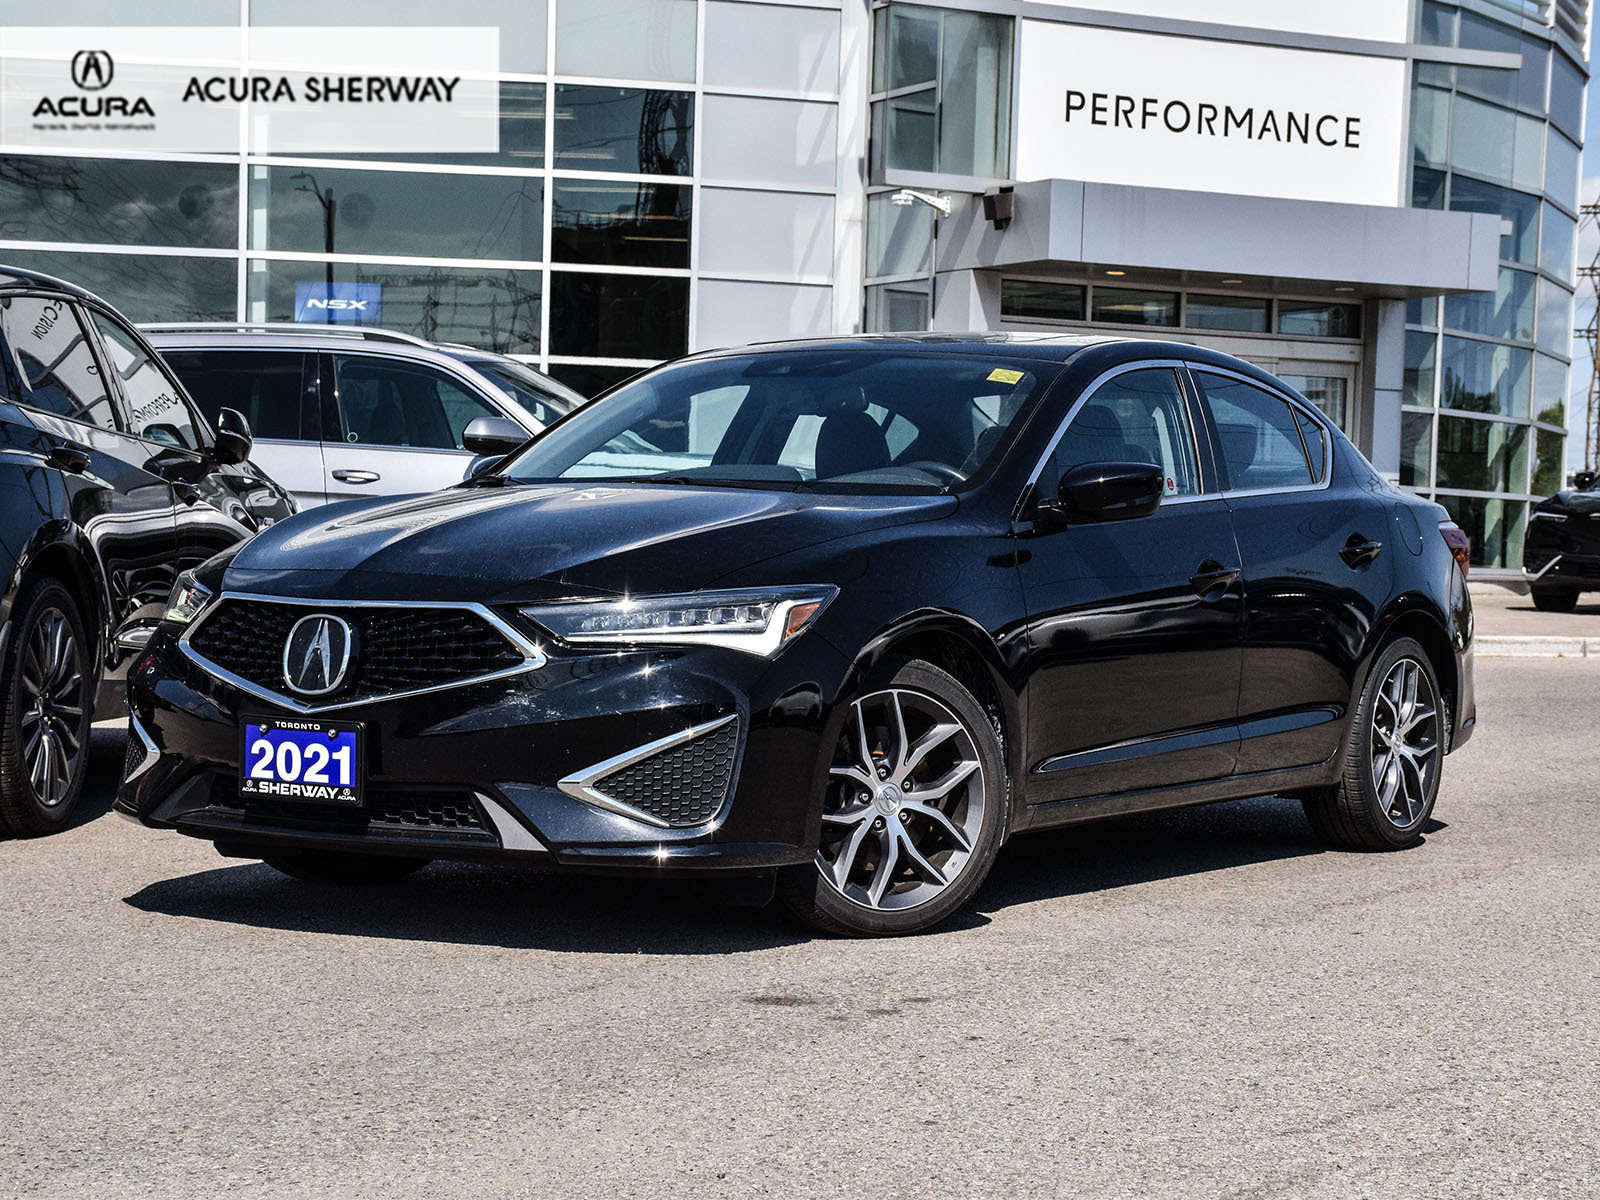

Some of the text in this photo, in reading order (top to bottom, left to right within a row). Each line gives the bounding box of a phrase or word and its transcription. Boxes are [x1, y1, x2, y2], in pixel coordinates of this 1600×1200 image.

[1065, 89, 1361, 148] PERFORMANCE
[306, 298, 368, 311] NSX
[275, 721, 321, 731] TORONTO
[250, 739, 350, 785] 2021
[258, 781, 339, 799] SHERWAY
